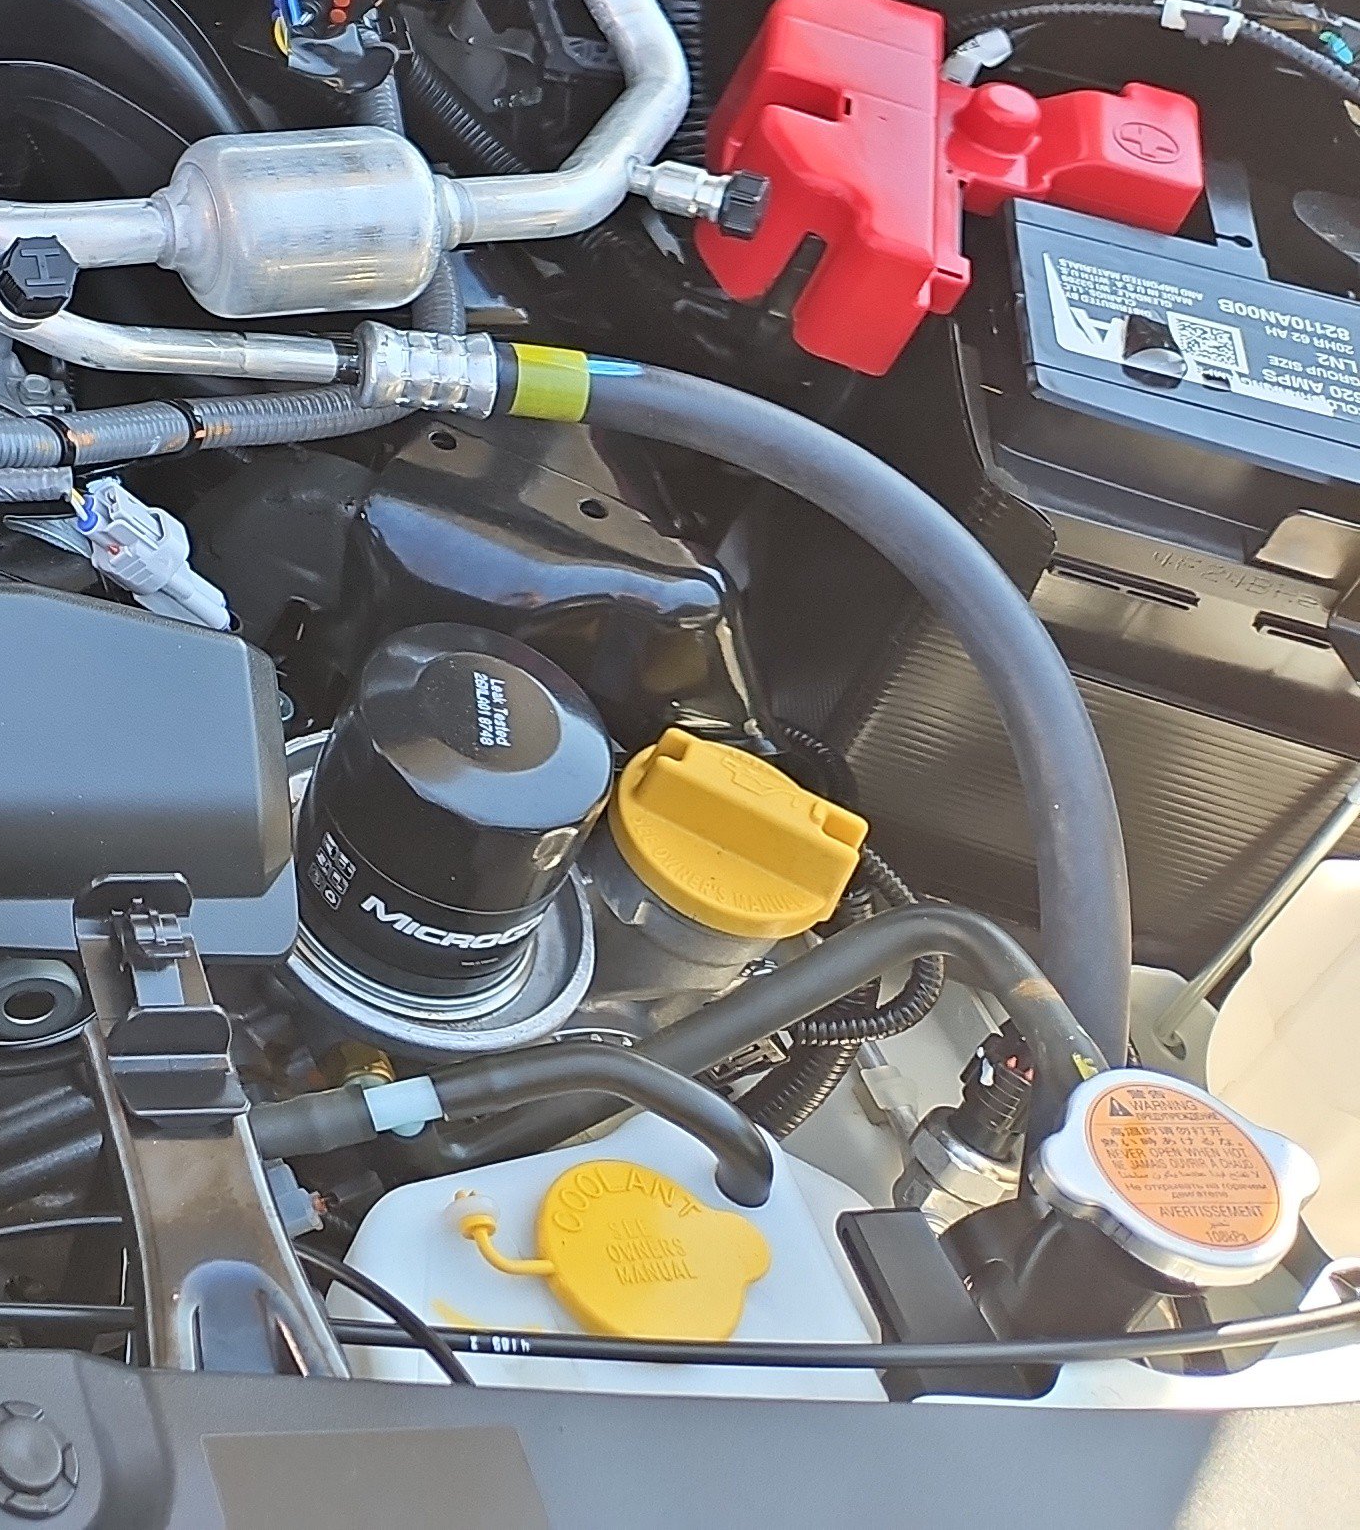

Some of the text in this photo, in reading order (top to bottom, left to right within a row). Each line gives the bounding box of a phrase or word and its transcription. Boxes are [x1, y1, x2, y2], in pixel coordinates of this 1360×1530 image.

[1216, 296, 1351, 342] 82110AN00B
[1263, 325, 1355, 355] 20HR 62 AH
[1266, 354, 1360, 386] GROUP SIZE
[1314, 351, 1359, 373] LN2
[1260, 368, 1324, 394] AMPS
[490, 678, 512, 747] Leak Tested
[1130, 1100, 1199, 1111] WARNING
[1106, 1148, 1248, 1159] NEVER OPEN WHEN HOT
[1129, 1159, 1167, 1169] JAMAIS
[552, 1170, 703, 1234] COOLANT
[1159, 1205, 1265, 1217] AVERTISSEMENT
[608, 1221, 649, 1241] SEE
[1205, 1230, 1249, 1243] 108kPa
[606, 1240, 688, 1263] OWNERS
[614, 1259, 698, 1285] MANUAL
